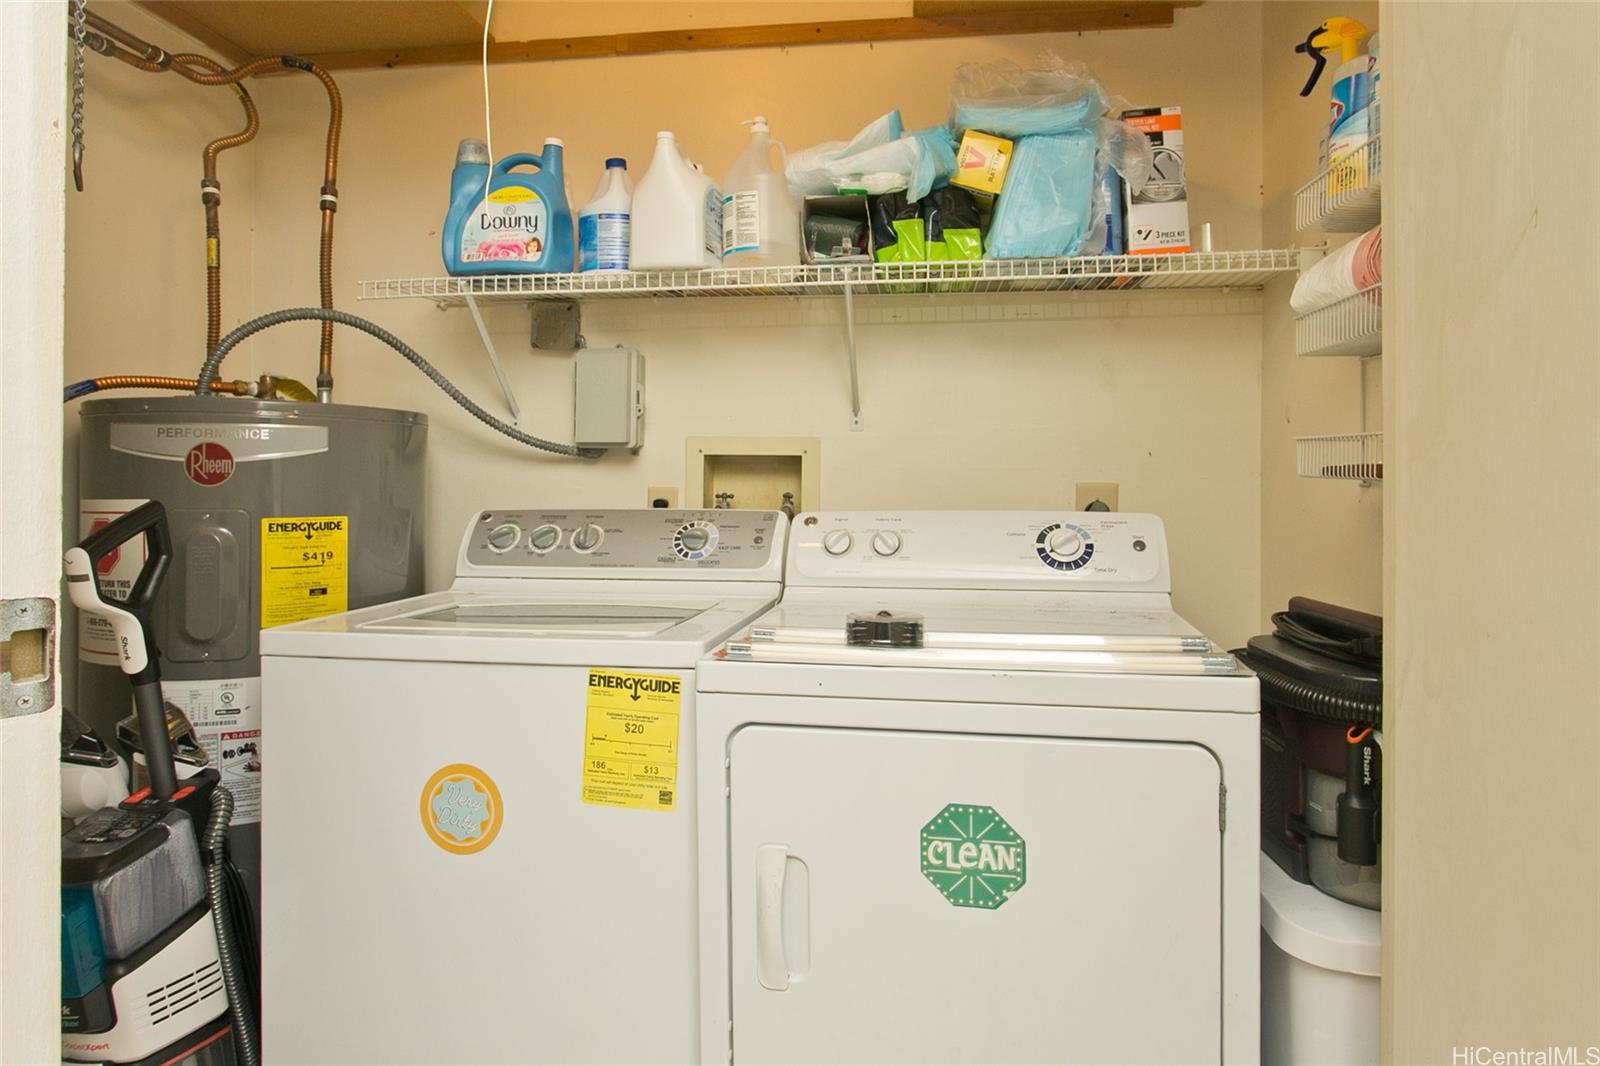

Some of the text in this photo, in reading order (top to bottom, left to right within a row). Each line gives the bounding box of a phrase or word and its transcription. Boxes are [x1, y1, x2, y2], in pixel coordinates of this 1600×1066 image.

[480, 212, 538, 233] Downy
[1155, 230, 1160, 239] 3
[156, 427, 269, 440] PERFORMANCE
[190, 444, 232, 479] Rheem
[268, 521, 343, 533] ENERGYGUIDE
[302, 551, 334, 561] $419
[117, 580, 131, 588] THIS
[118, 589, 127, 599] TO
[120, 636, 131, 661] Shark
[589, 674, 681, 694] ENERGYGUIDE
[624, 722, 645, 735] $20
[592, 760, 606, 770] 186
[643, 765, 659, 775] $13
[1363, 746, 1373, 785] Shark
[447, 783, 482, 809] Very
